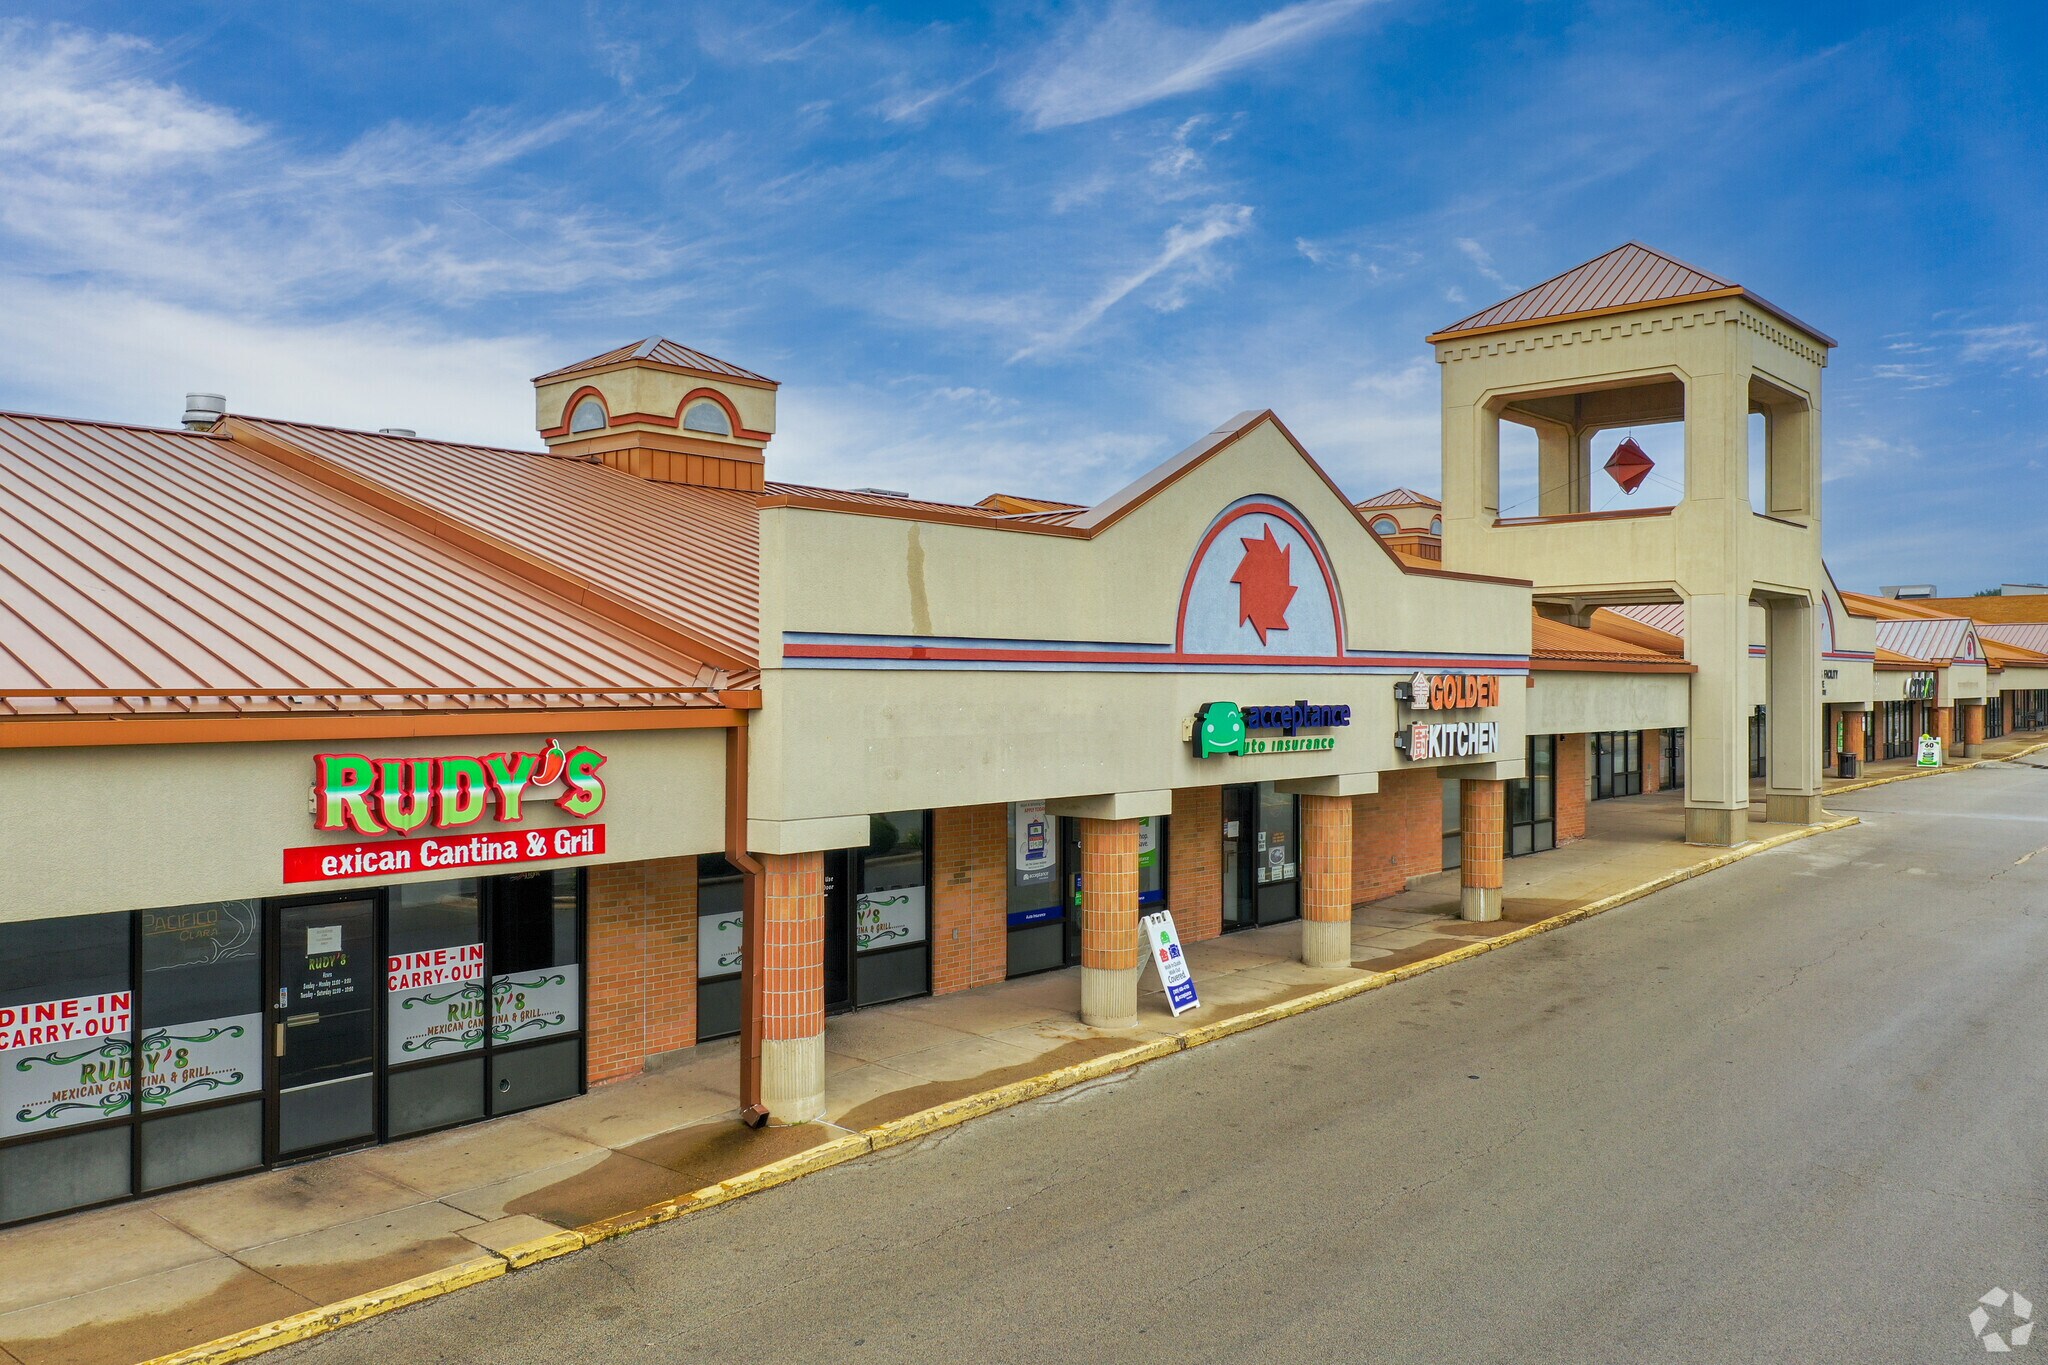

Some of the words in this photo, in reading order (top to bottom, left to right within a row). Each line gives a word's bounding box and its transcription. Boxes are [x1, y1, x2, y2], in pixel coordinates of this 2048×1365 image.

[1430, 675, 1499, 710] GOLDEN
[1247, 700, 1351, 737] acceptance
[1243, 738, 1266, 754] uto
[1271, 737, 1335, 752] insurance
[1429, 721, 1499, 759] KITCHEN
[313, 739, 607, 837] RUDY'S
[420, 840, 518, 868] Cantina
[526, 831, 547, 857] &
[145, 909, 219, 930] PACIFICO
[309, 953, 348, 971] RUDY'S
[388, 945, 483, 973] DINE-IN
[388, 962, 483, 991] CARRY-OUT
[0, 992, 130, 1028] DINE-IN
[512, 1012, 518, 1023] &
[0, 1014, 130, 1050] CARRY-OUT
[170, 1072, 178, 1084] &
